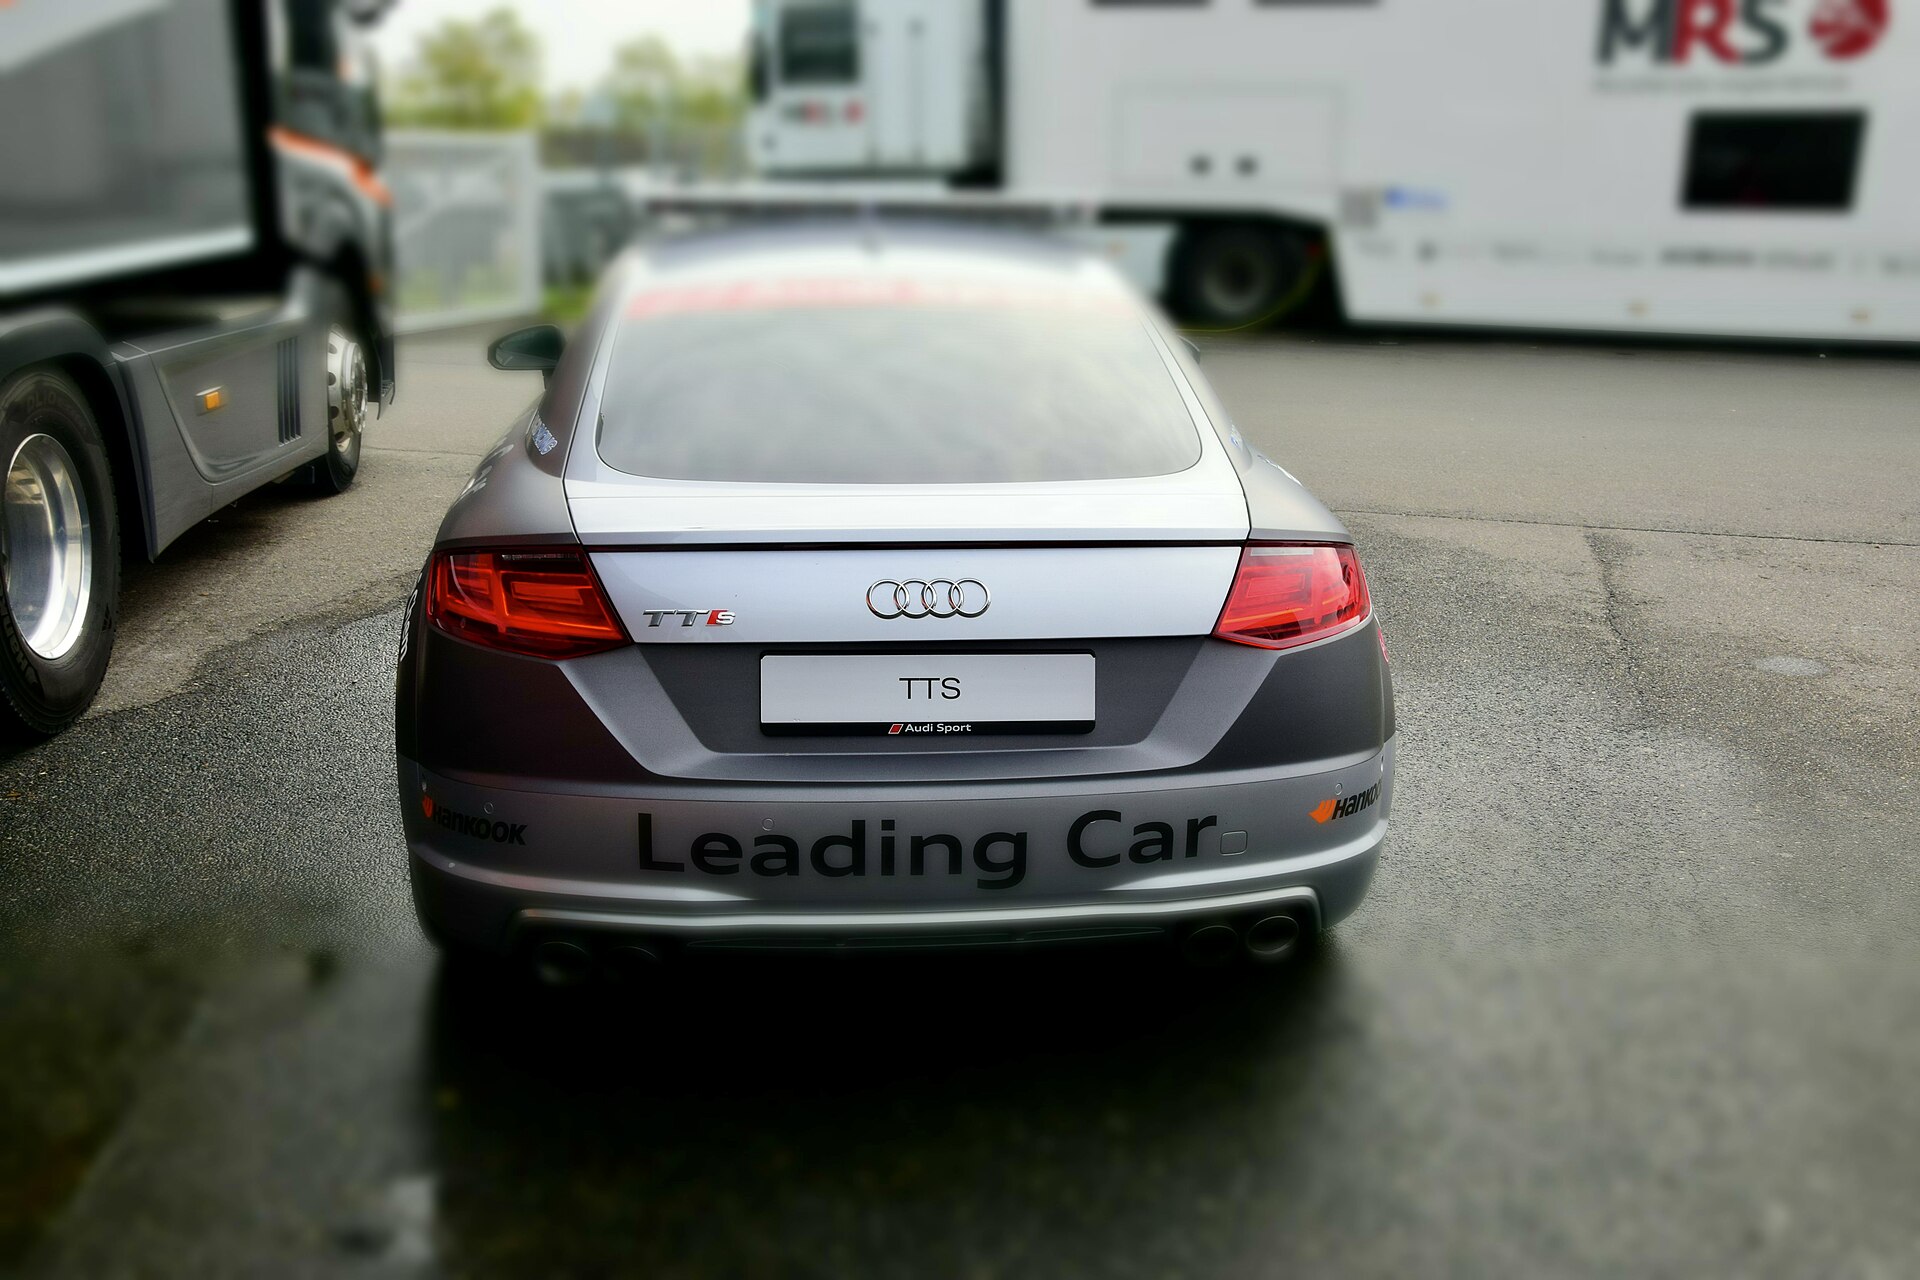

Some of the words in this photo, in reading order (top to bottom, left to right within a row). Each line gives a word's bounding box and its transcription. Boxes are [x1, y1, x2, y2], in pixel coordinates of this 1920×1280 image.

[1596, 0, 1788, 64] MRS
[643, 609, 736, 627] TTS
[898, 676, 961, 700] TTS
[904, 723, 934, 732] Audi
[936, 723, 972, 734] Sport
[638, 812, 1028, 889] Leading
[1066, 810, 1218, 867] Car
